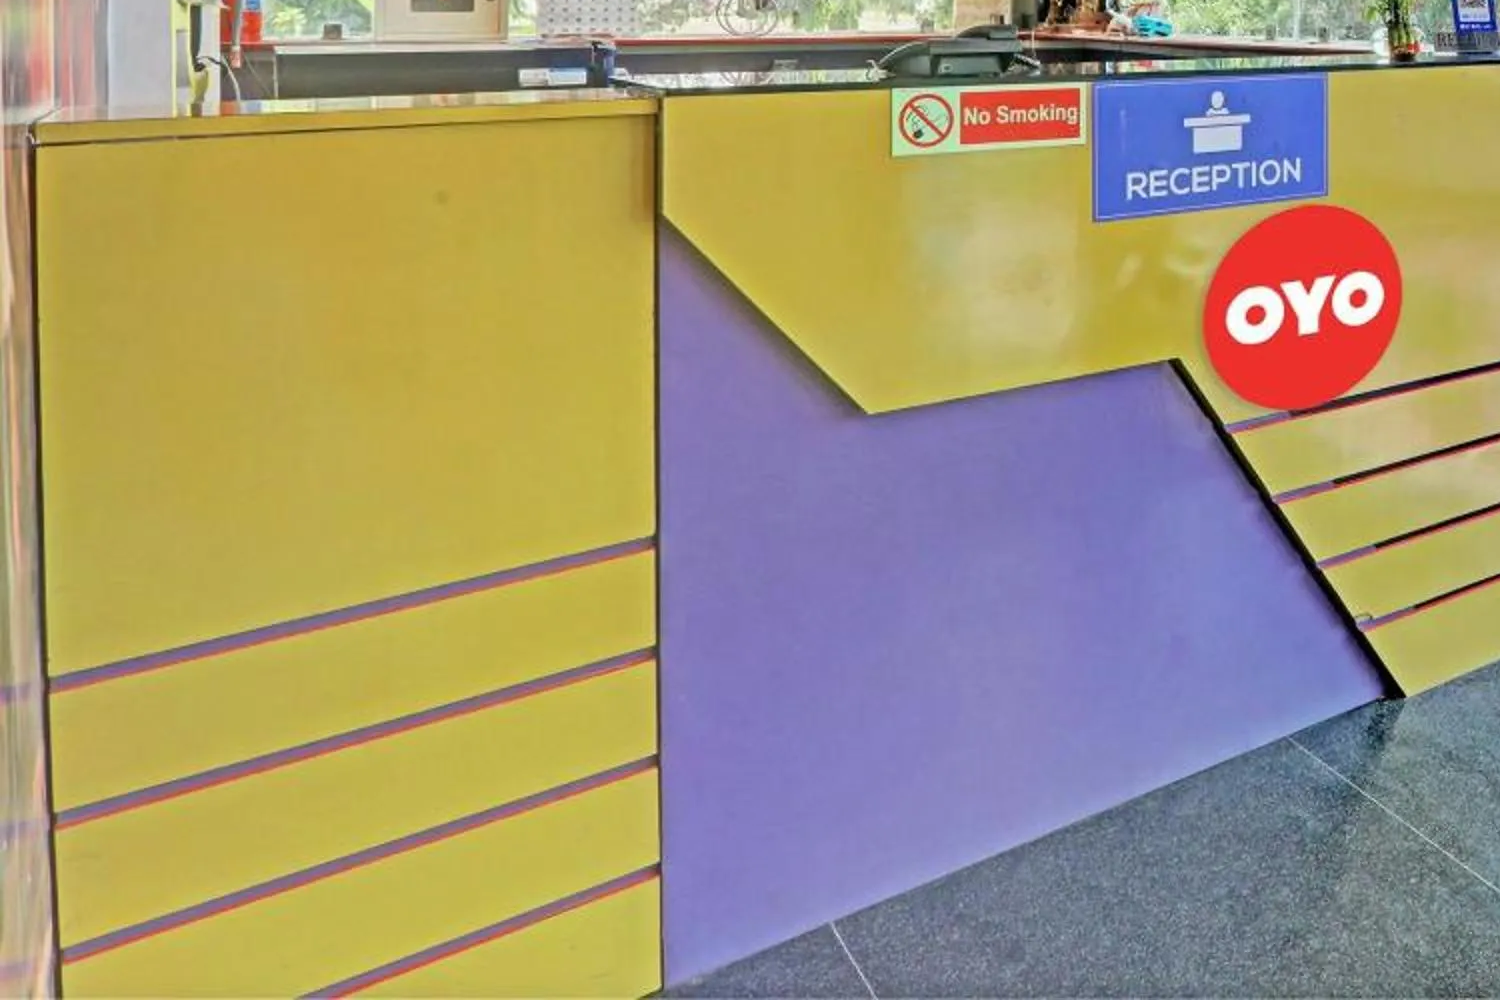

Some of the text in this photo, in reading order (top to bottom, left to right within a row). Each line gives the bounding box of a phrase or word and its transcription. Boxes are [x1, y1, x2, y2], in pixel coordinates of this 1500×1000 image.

[963, 103, 1078, 126] No Smoking
[1126, 157, 1302, 201] RECEPTION
[1225, 271, 1385, 345] OYO
